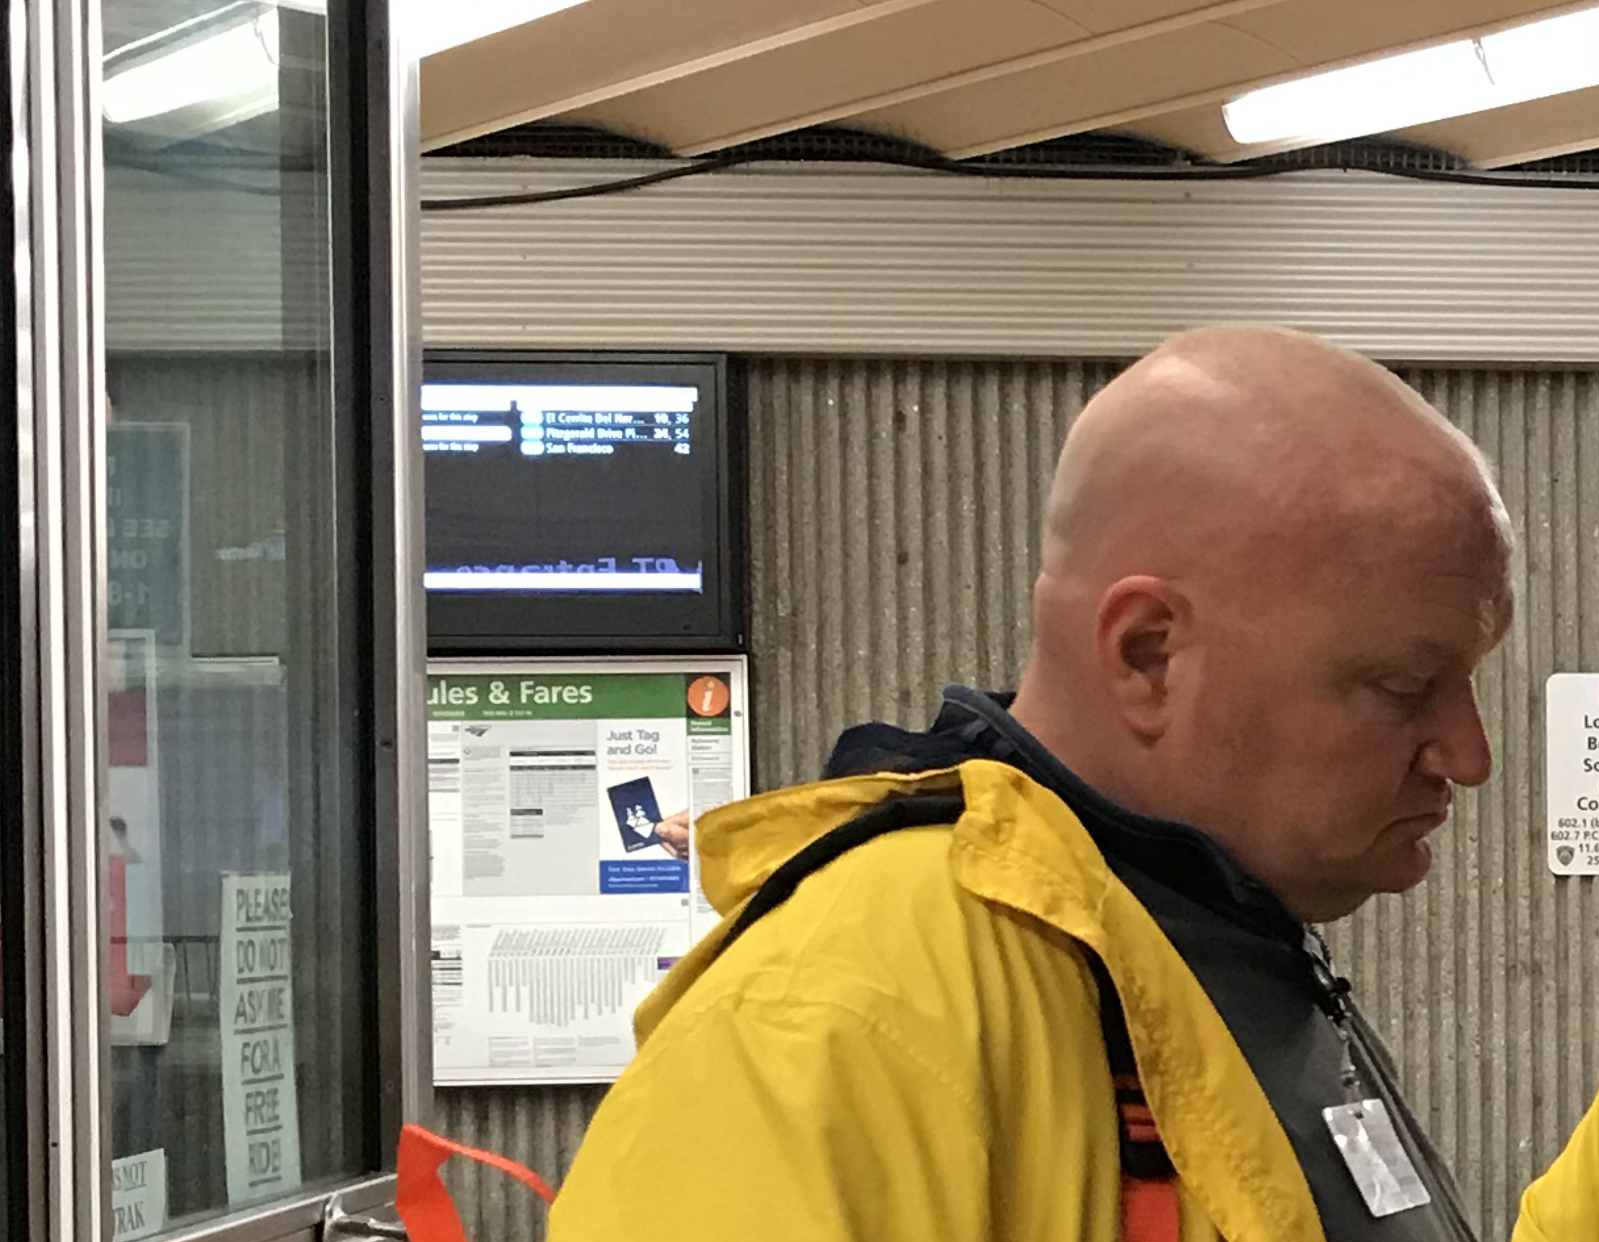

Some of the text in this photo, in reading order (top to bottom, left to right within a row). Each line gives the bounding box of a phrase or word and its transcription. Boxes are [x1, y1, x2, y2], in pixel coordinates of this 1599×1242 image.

[675, 412, 690, 425] 36
[674, 427, 690, 439] 54
[545, 442, 565, 454] San
[566, 442, 614, 454] Francisco
[488, 680, 511, 705] &
[519, 680, 593, 704] Fares
[606, 729, 660, 743] Just Tag
[606, 743, 658, 756] and Go!
[236, 887, 290, 922] PLEASE
[236, 937, 286, 974] DO NOT
[241, 1035, 282, 1076] FOR A
[245, 1087, 280, 1126] FREE
[122, 1161, 147, 1190] NOT
